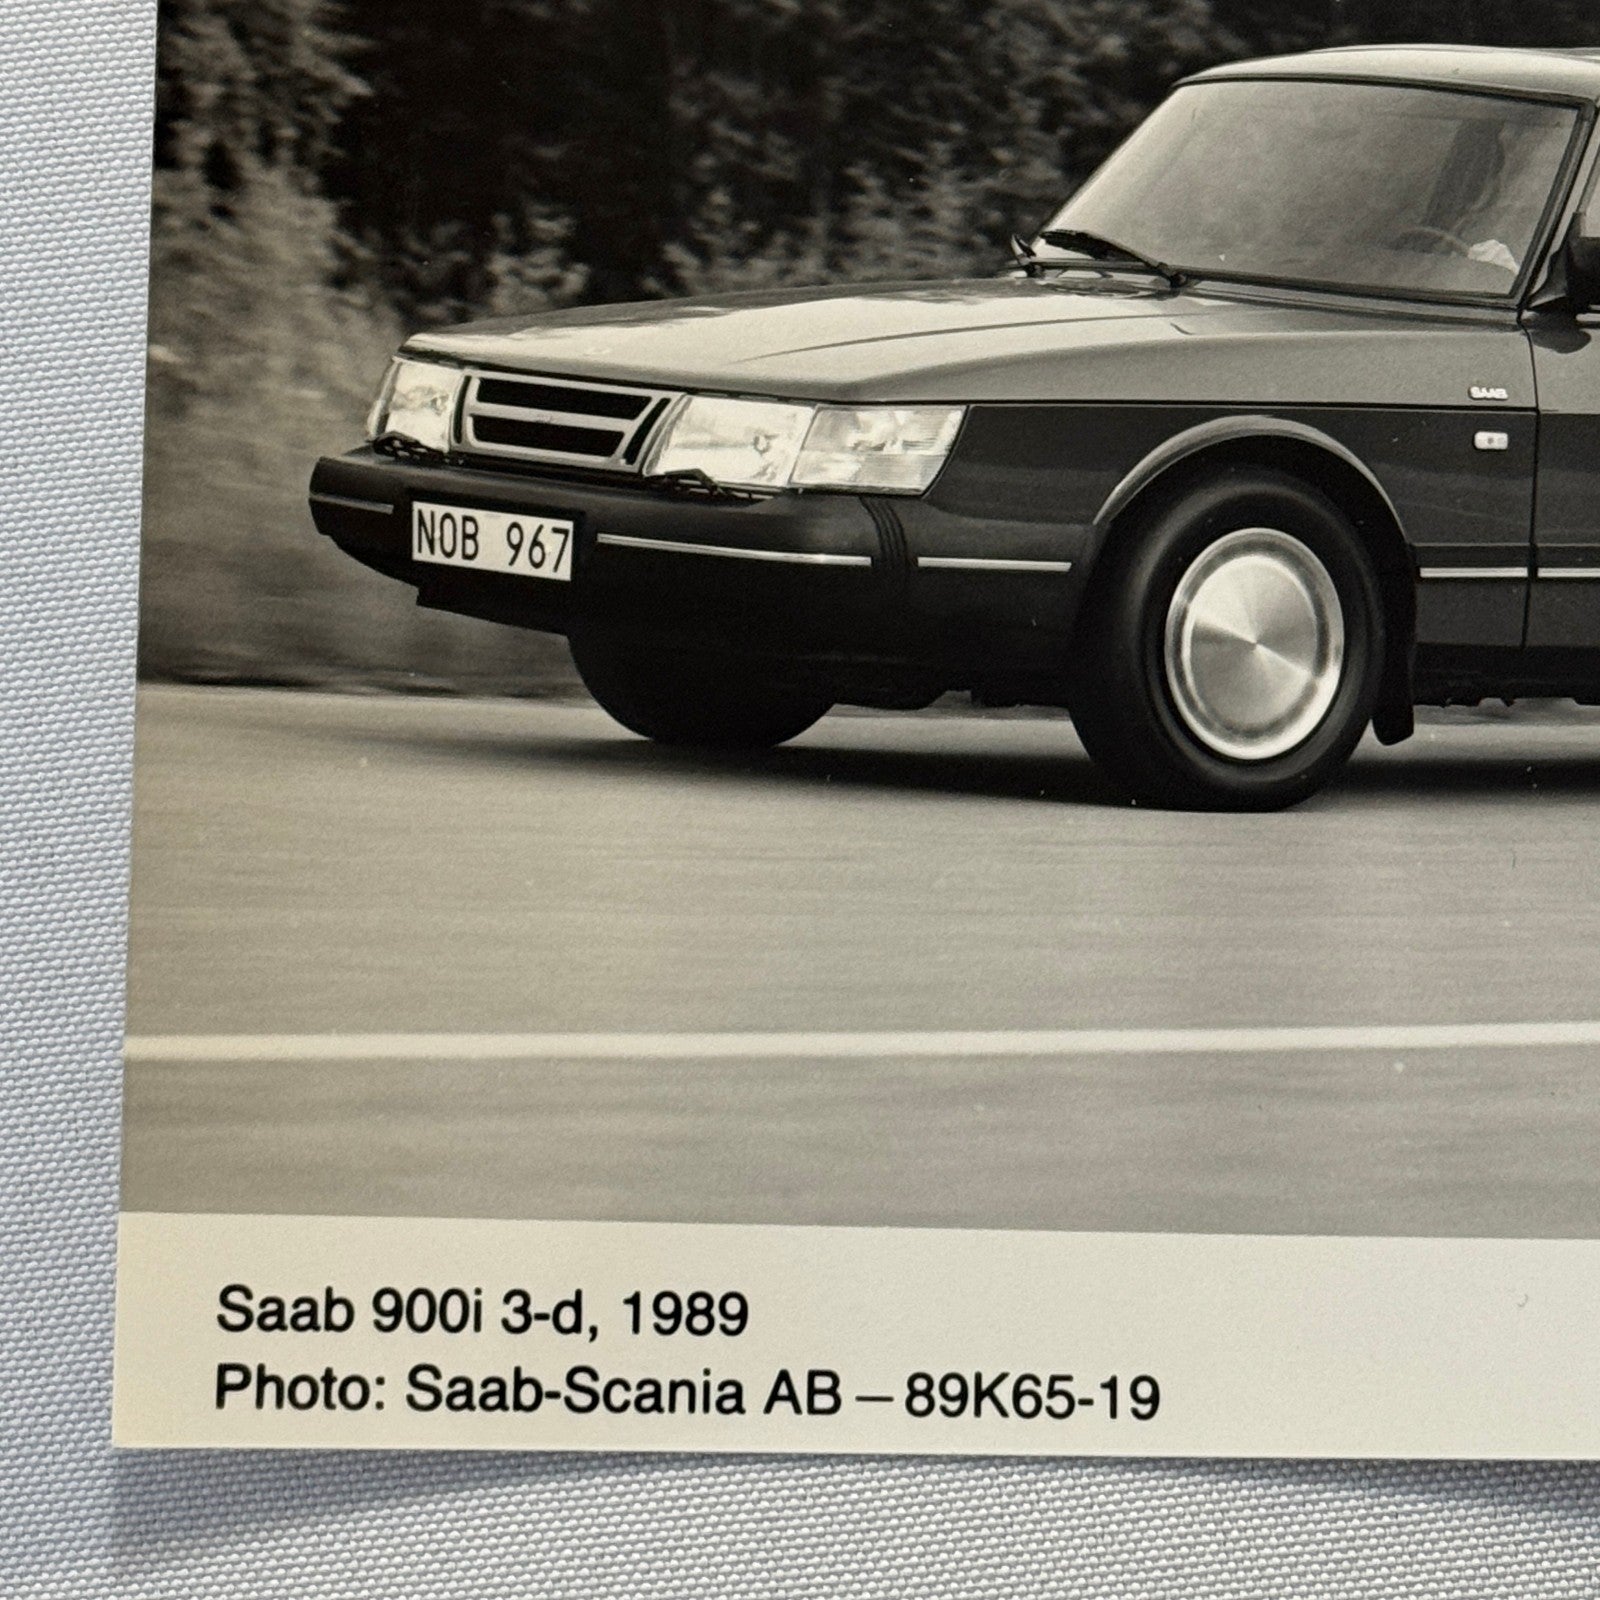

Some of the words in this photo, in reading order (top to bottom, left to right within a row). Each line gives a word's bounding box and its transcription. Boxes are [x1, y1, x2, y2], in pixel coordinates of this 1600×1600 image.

[417, 508, 479, 561] NOB
[506, 521, 570, 573] 967
[216, 1283, 355, 1333] Saab
[371, 1286, 483, 1334] 900i
[500, 1288, 598, 1343] 3-d,
[622, 1290, 749, 1337] 1989
[215, 1362, 386, 1411] Photo:
[405, 1363, 747, 1416] Saab-Scania
[763, 1368, 842, 1416] AB
[904, 1371, 1161, 1421] 89K65-19
